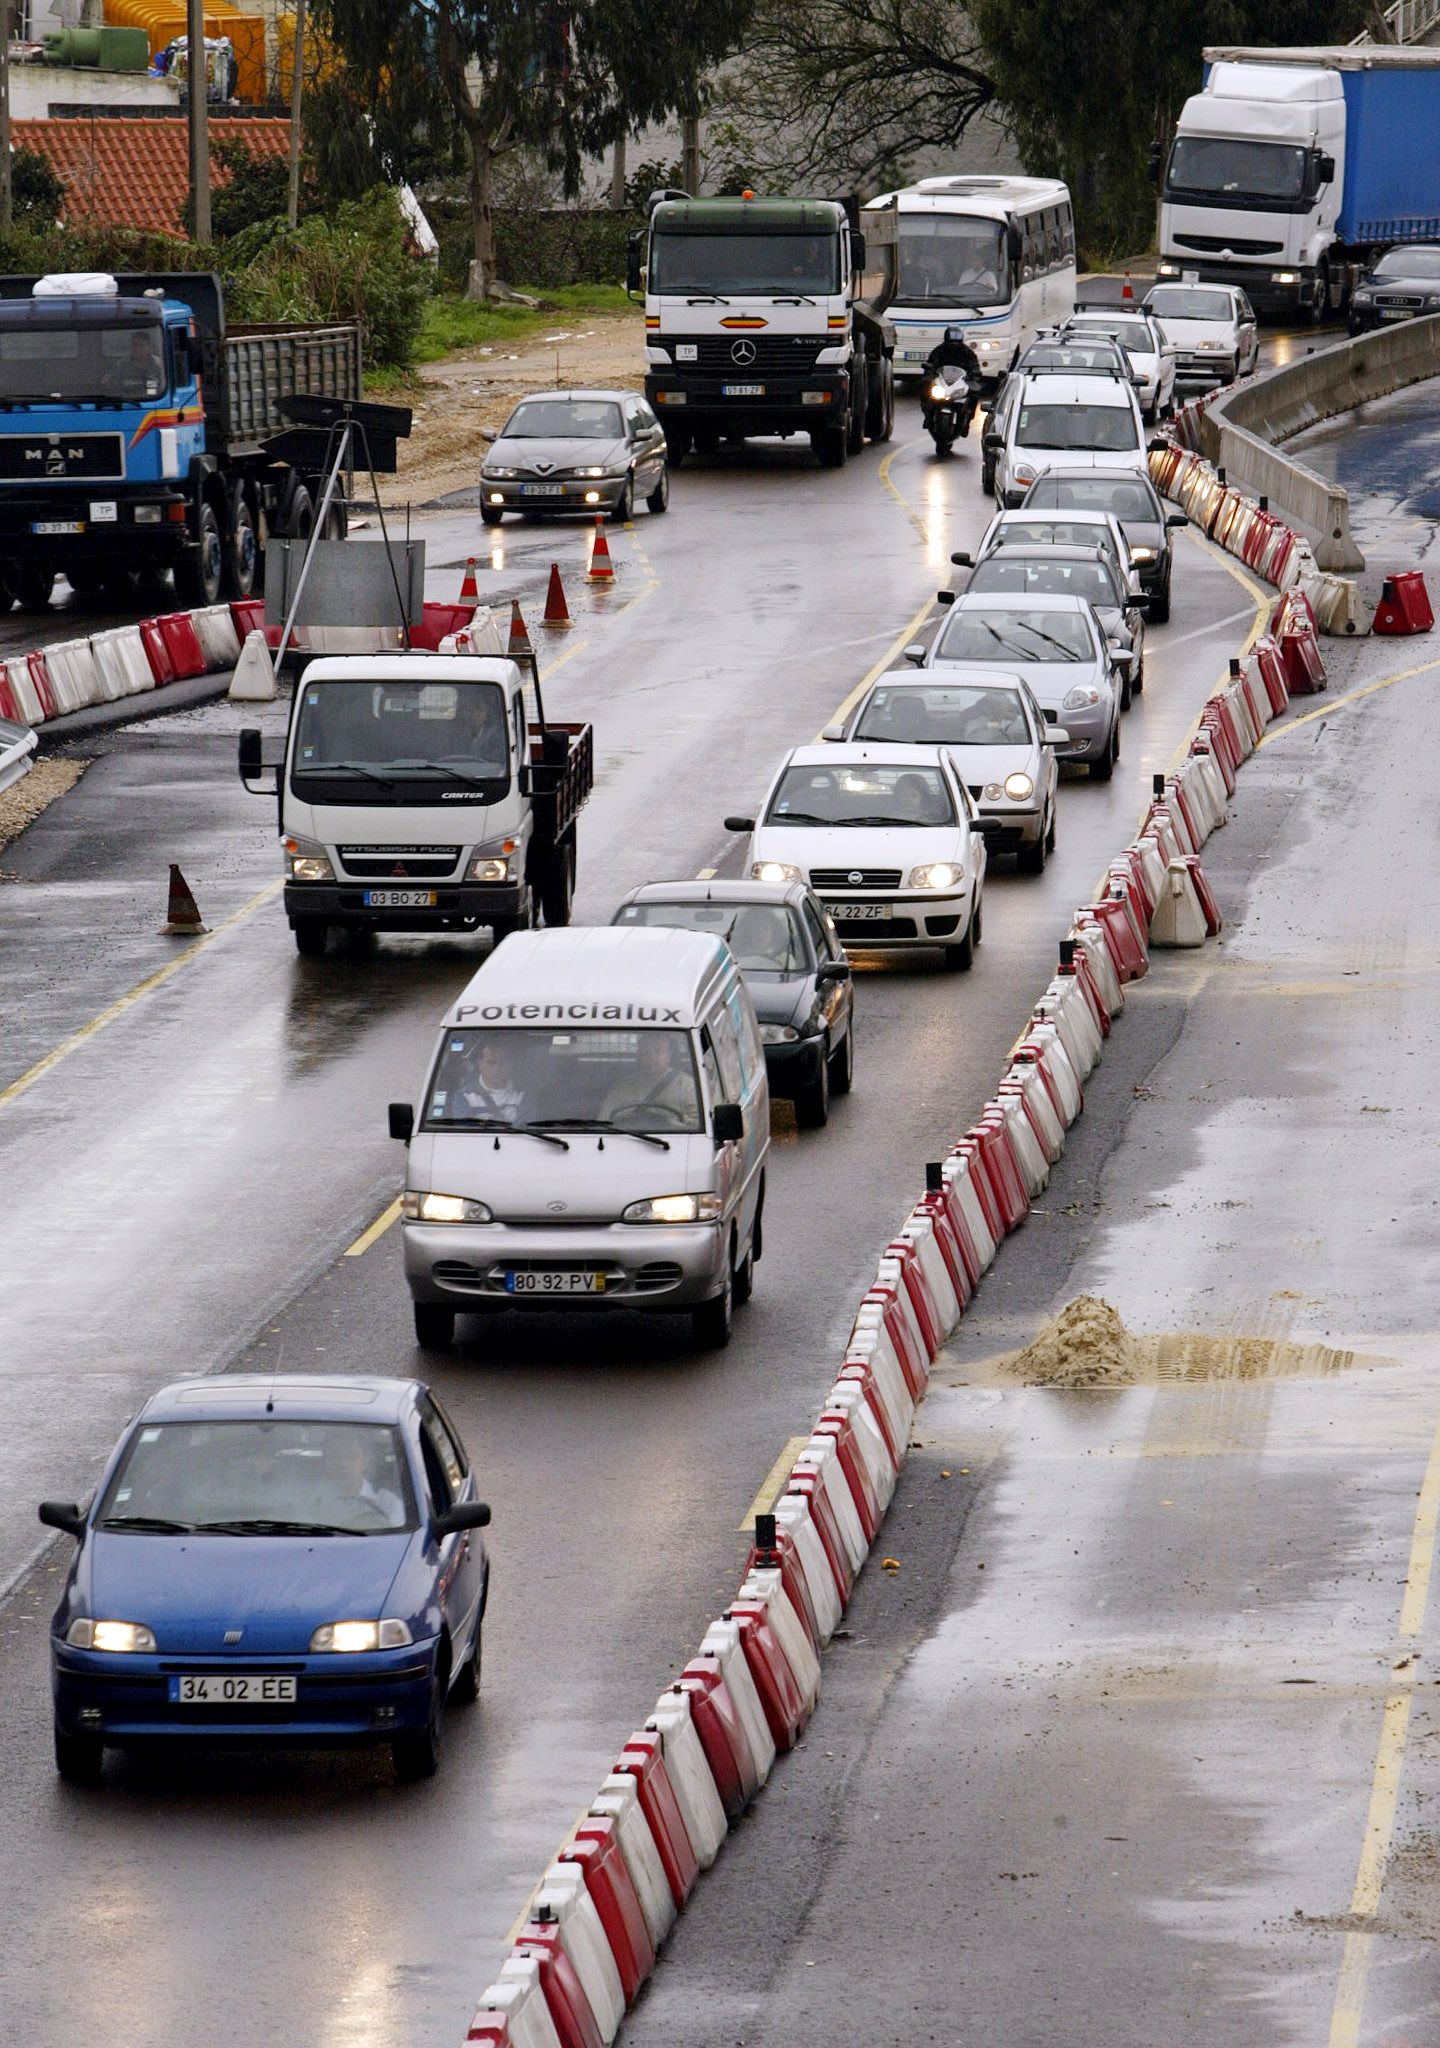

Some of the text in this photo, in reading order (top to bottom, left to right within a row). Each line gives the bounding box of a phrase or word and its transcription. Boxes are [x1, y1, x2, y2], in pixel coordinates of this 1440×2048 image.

[25, 448, 84, 460] MAN
[456, 1002, 681, 1023] Potencialux
[516, 1274, 594, 1290] 80-92-PV
[183, 1679, 293, 1700] 34-02-EE
